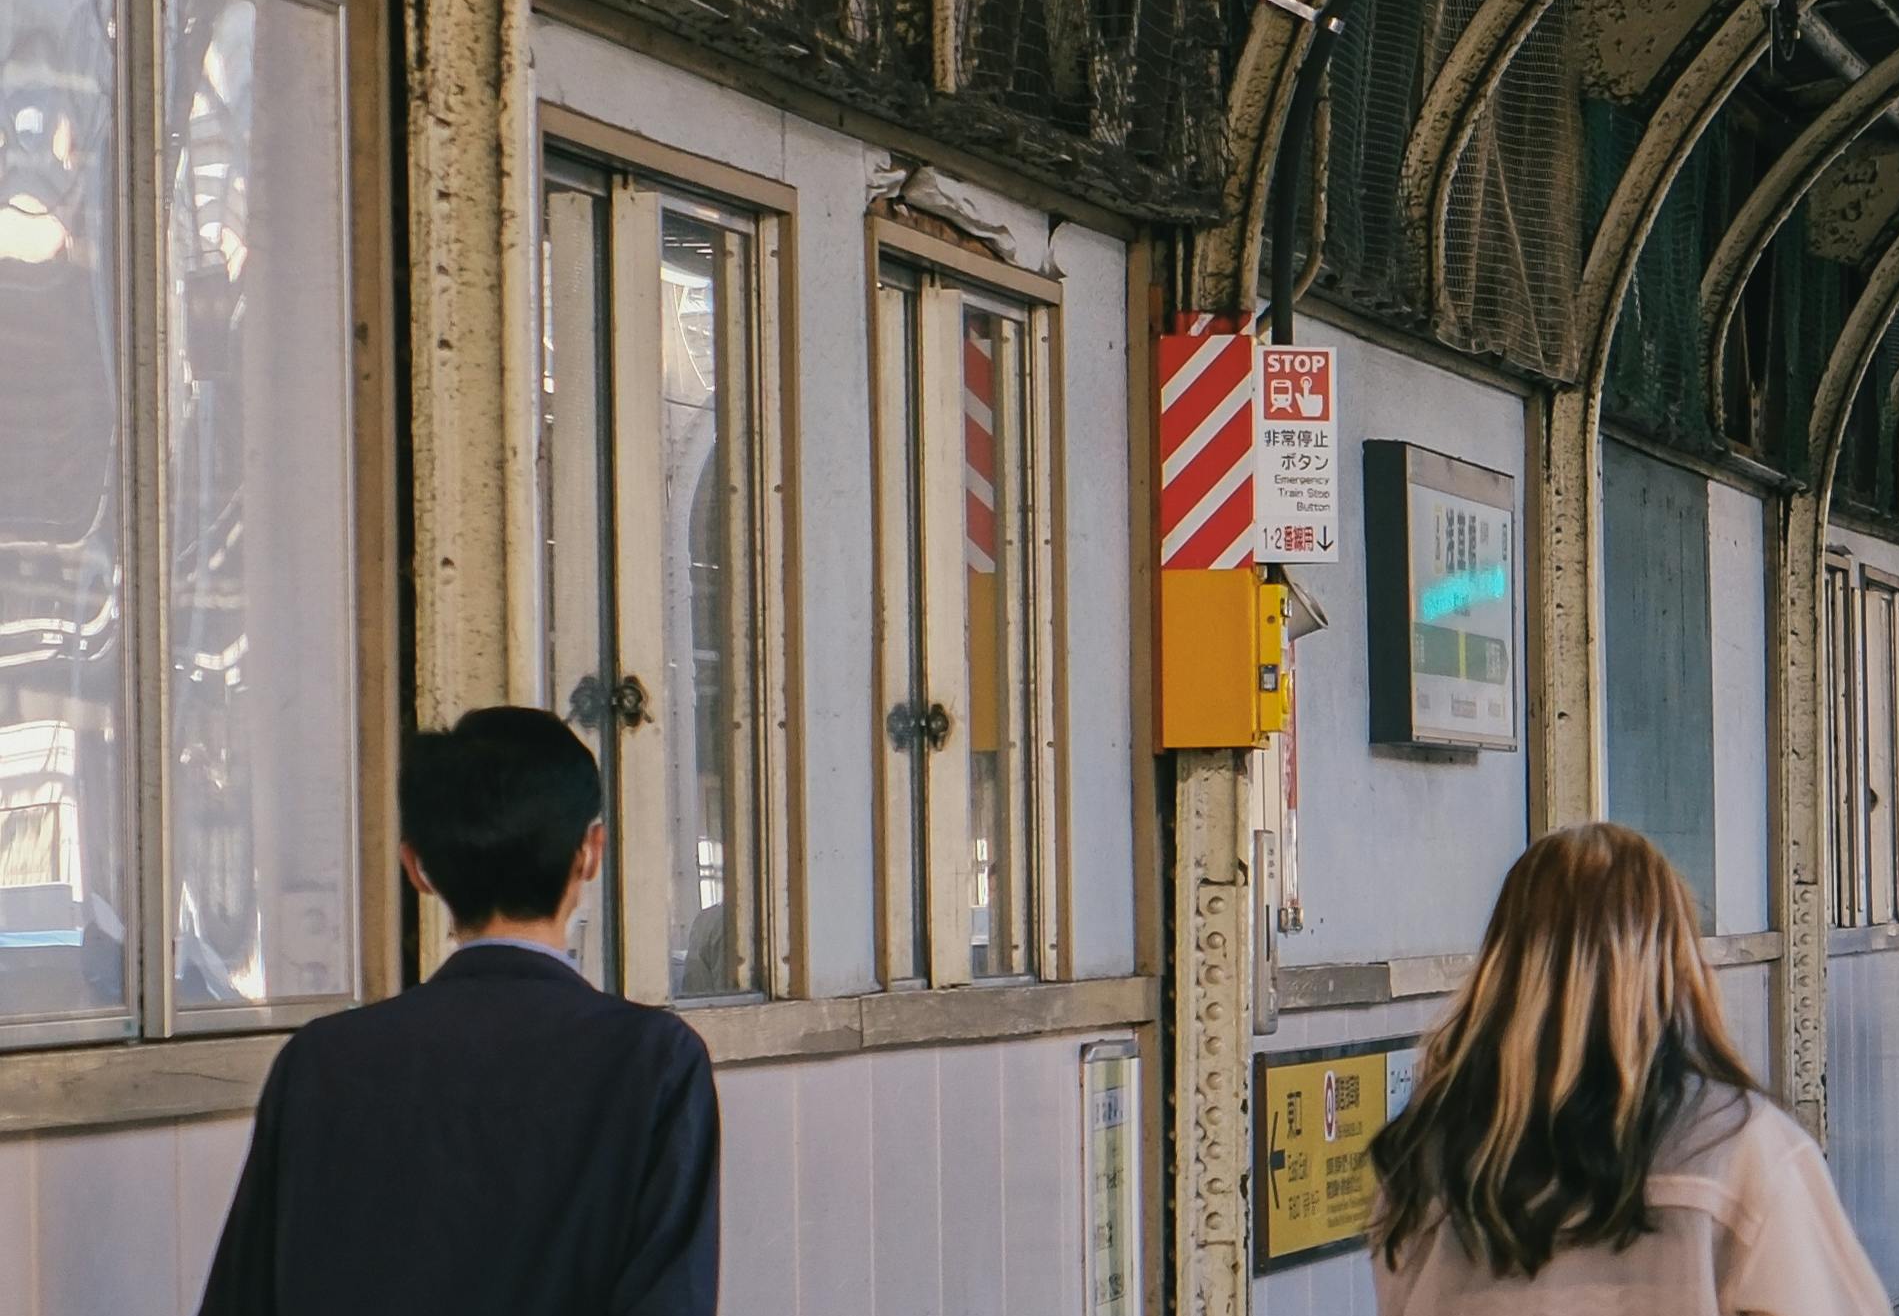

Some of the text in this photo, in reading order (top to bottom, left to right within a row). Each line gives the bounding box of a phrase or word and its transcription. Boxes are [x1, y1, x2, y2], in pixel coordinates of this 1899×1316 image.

[1266, 354, 1326, 374] STOP
[1264, 429, 1329, 449] 非常停止
[1281, 453, 1329, 471] ボタン
[1274, 474, 1330, 486] Emergency
[1278, 487, 1330, 499] Train Stop
[1296, 501, 1331, 512] Button
